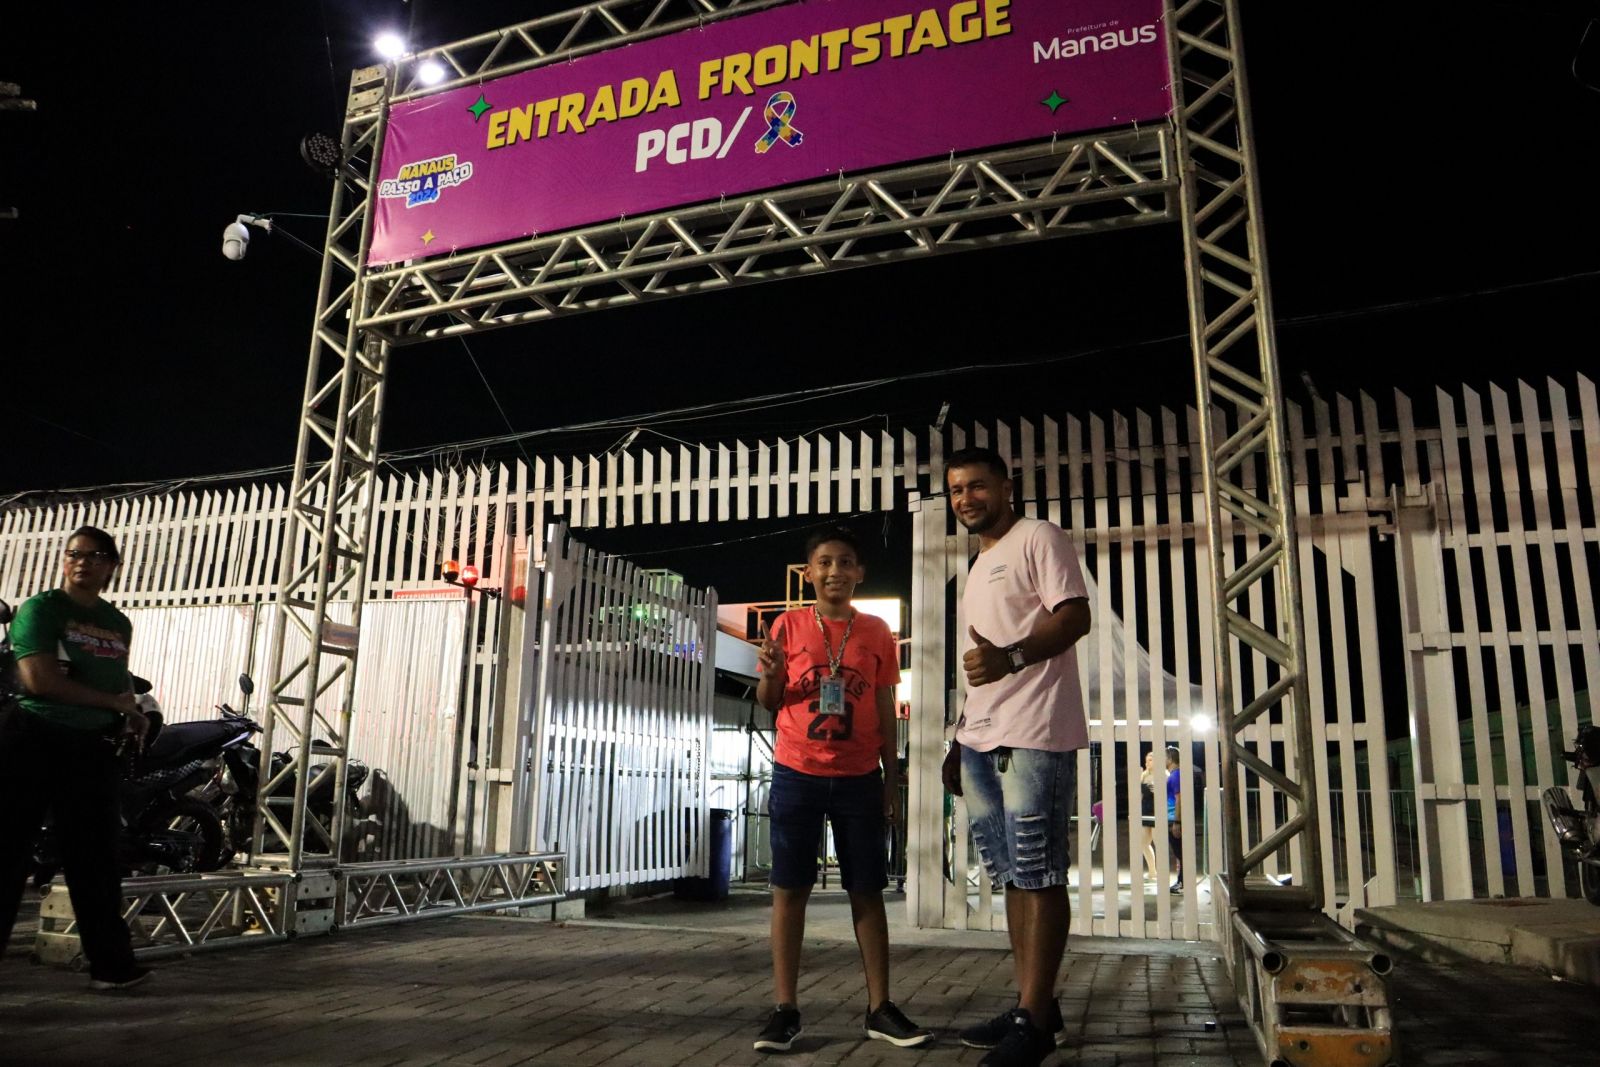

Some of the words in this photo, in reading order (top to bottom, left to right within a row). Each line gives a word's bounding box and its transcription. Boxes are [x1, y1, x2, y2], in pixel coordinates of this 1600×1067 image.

[1067, 22, 1107, 35] Prefeitura
[1109, 19, 1119, 27] de
[1033, 24, 1157, 64] Manaus
[486, 70, 680, 150] ENTRADA
[698, 0, 1013, 101] FRONTSTAGE
[635, 107, 753, 173] PCD/
[381, 180, 421, 195] PASSO
[424, 176, 434, 190] A
[437, 165, 470, 185] PAÇO
[400, 157, 455, 180] MANAUS
[408, 190, 438, 205] 2024
[800, 671, 868, 696] PAIS
[807, 701, 854, 740] 23
